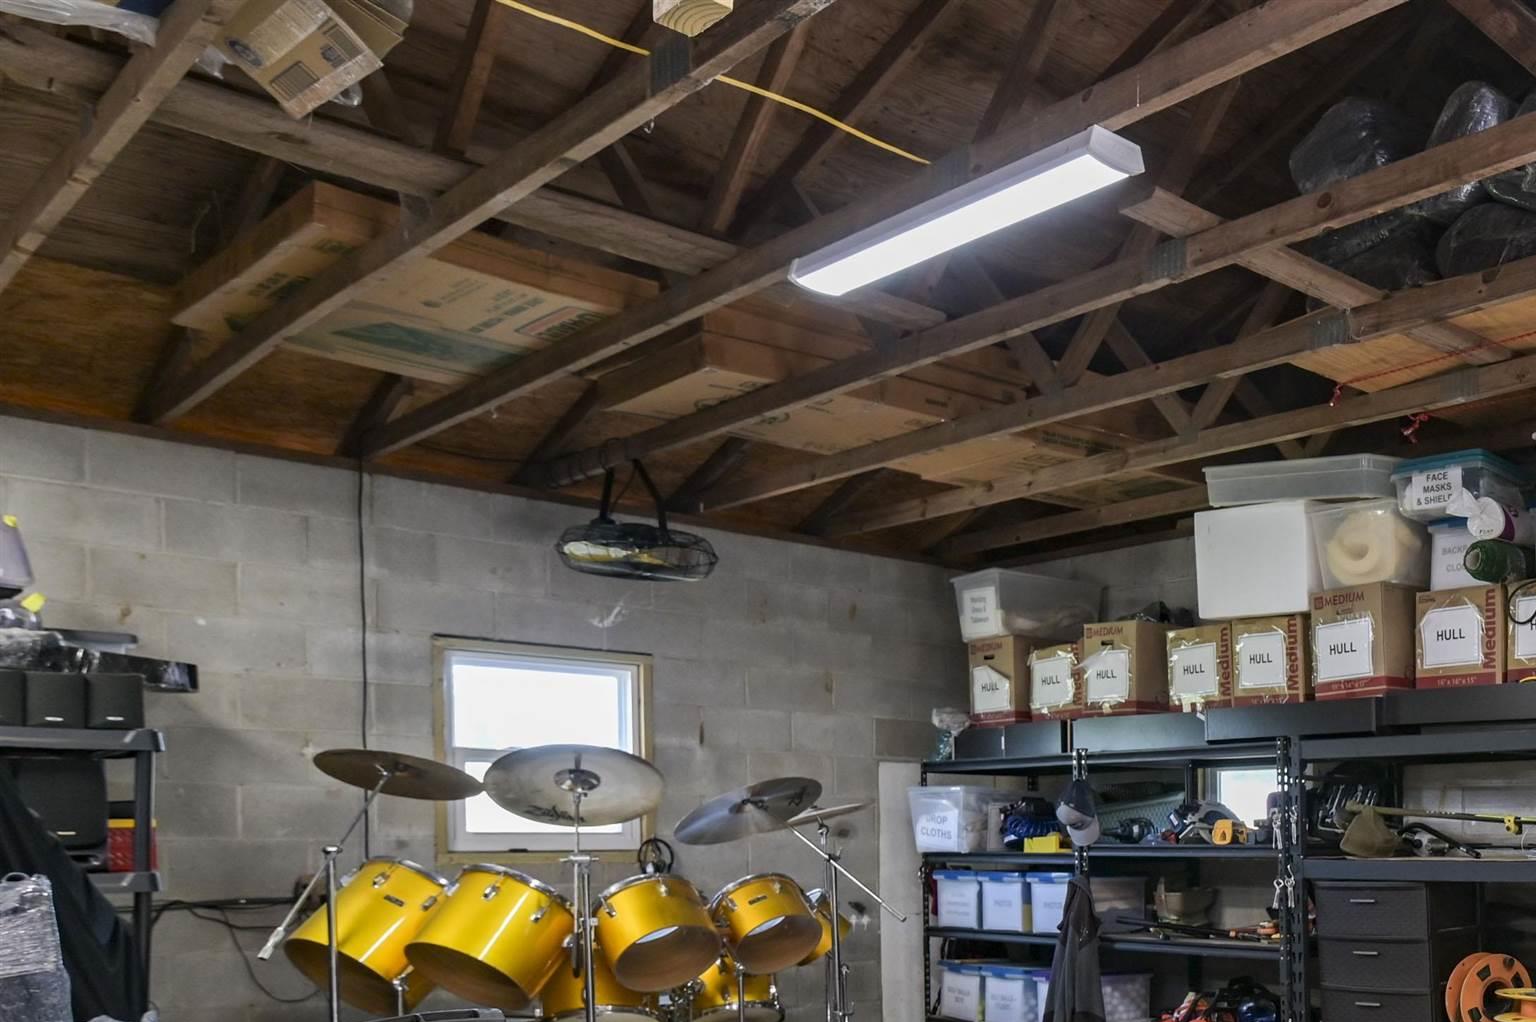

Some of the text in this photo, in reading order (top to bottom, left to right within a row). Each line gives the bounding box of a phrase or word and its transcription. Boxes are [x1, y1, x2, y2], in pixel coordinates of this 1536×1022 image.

[1426, 471, 1449, 482] FACE
[1423, 483, 1453, 493] MASKS
[1416, 497, 1423, 506] &
[1324, 591, 1365, 607] MEDIUM
[1436, 628, 1466, 641] HULL
[1286, 617, 1299, 691] Medium
[1329, 642, 1357, 655] HULL
[1218, 626, 1231, 699] Medium
[1249, 653, 1273, 664] HULL
[1096, 669, 1117, 679] HULL
[1183, 664, 1205, 675] HULL
[1041, 675, 1061, 686] HULL
[981, 682, 1000, 692] HULL
[926, 814, 948, 825] DROP
[920, 827, 953, 840] CLOTHS
